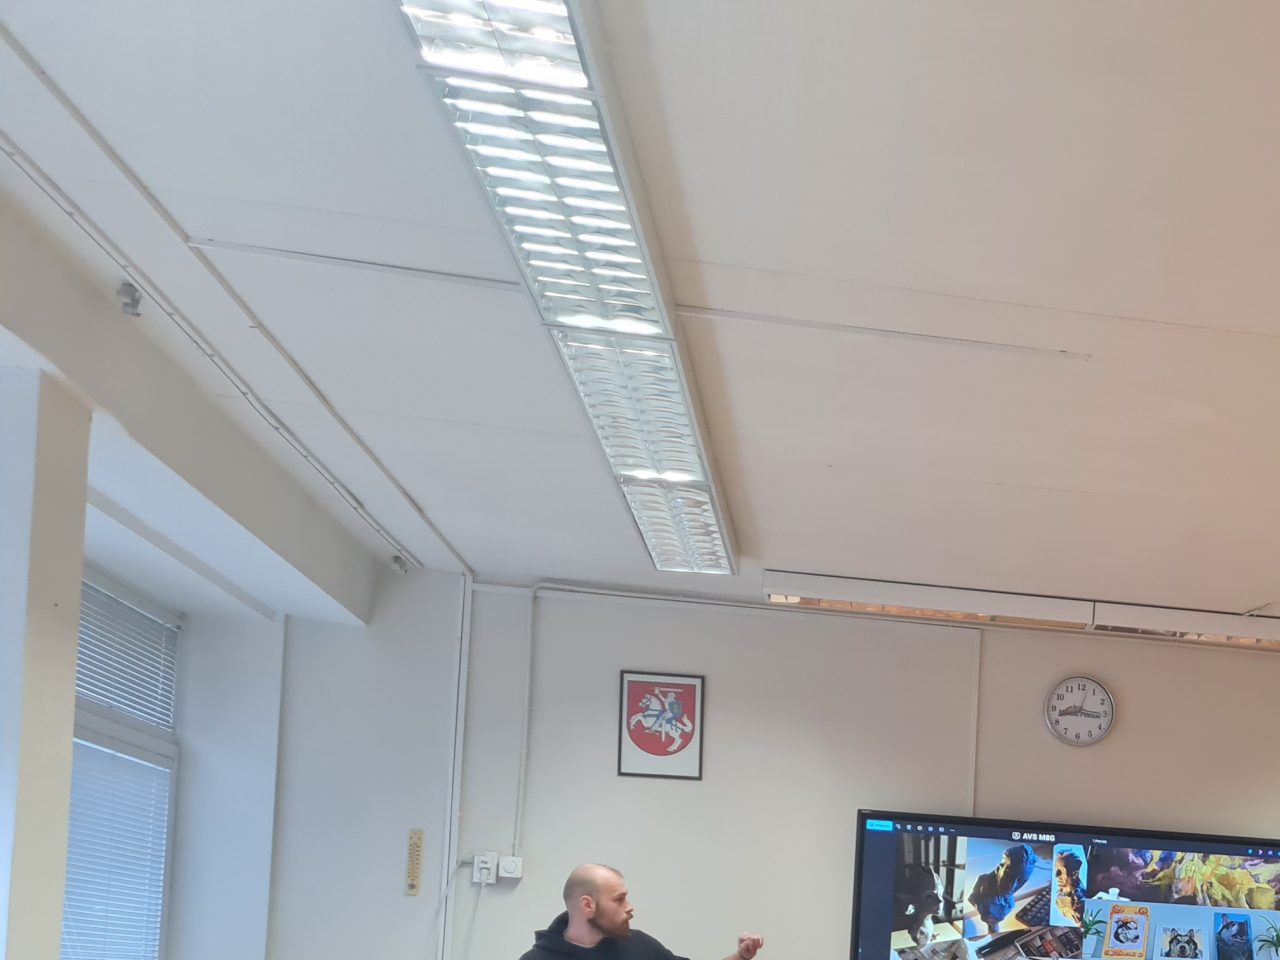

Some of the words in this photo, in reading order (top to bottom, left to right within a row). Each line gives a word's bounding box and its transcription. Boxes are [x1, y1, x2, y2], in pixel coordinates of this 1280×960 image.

[1065, 685, 1074, 693] 11
[1077, 683, 1087, 691] 12
[1056, 693, 1065, 701] 10
[1051, 704, 1057, 712] 9
[1103, 710, 1108, 718] 3
[1054, 718, 1060, 726] 8
[1063, 727, 1068, 735] 7
[1075, 732, 1080, 740] 6
[1022, 832, 1038, 840] AVS
